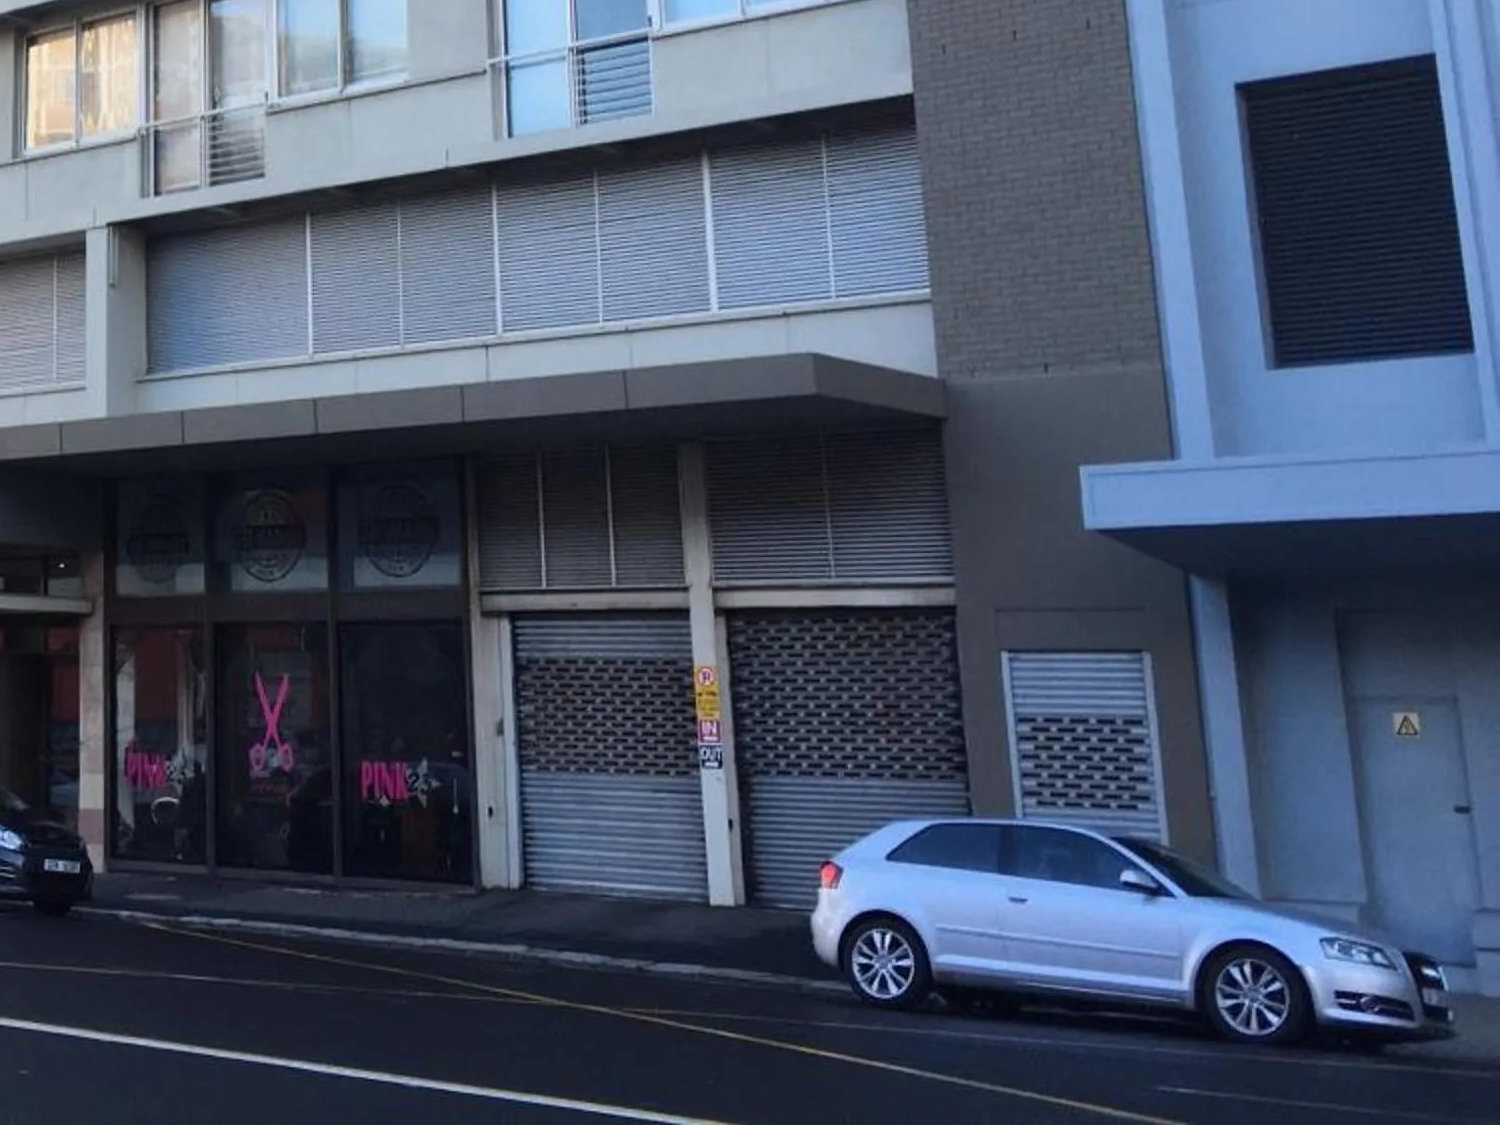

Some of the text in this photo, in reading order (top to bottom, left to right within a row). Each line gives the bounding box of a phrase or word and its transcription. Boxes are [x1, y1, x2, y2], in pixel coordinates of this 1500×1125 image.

[701, 720, 718, 735] IN
[700, 746, 723, 761] OUT
[361, 760, 409, 801] PINK
